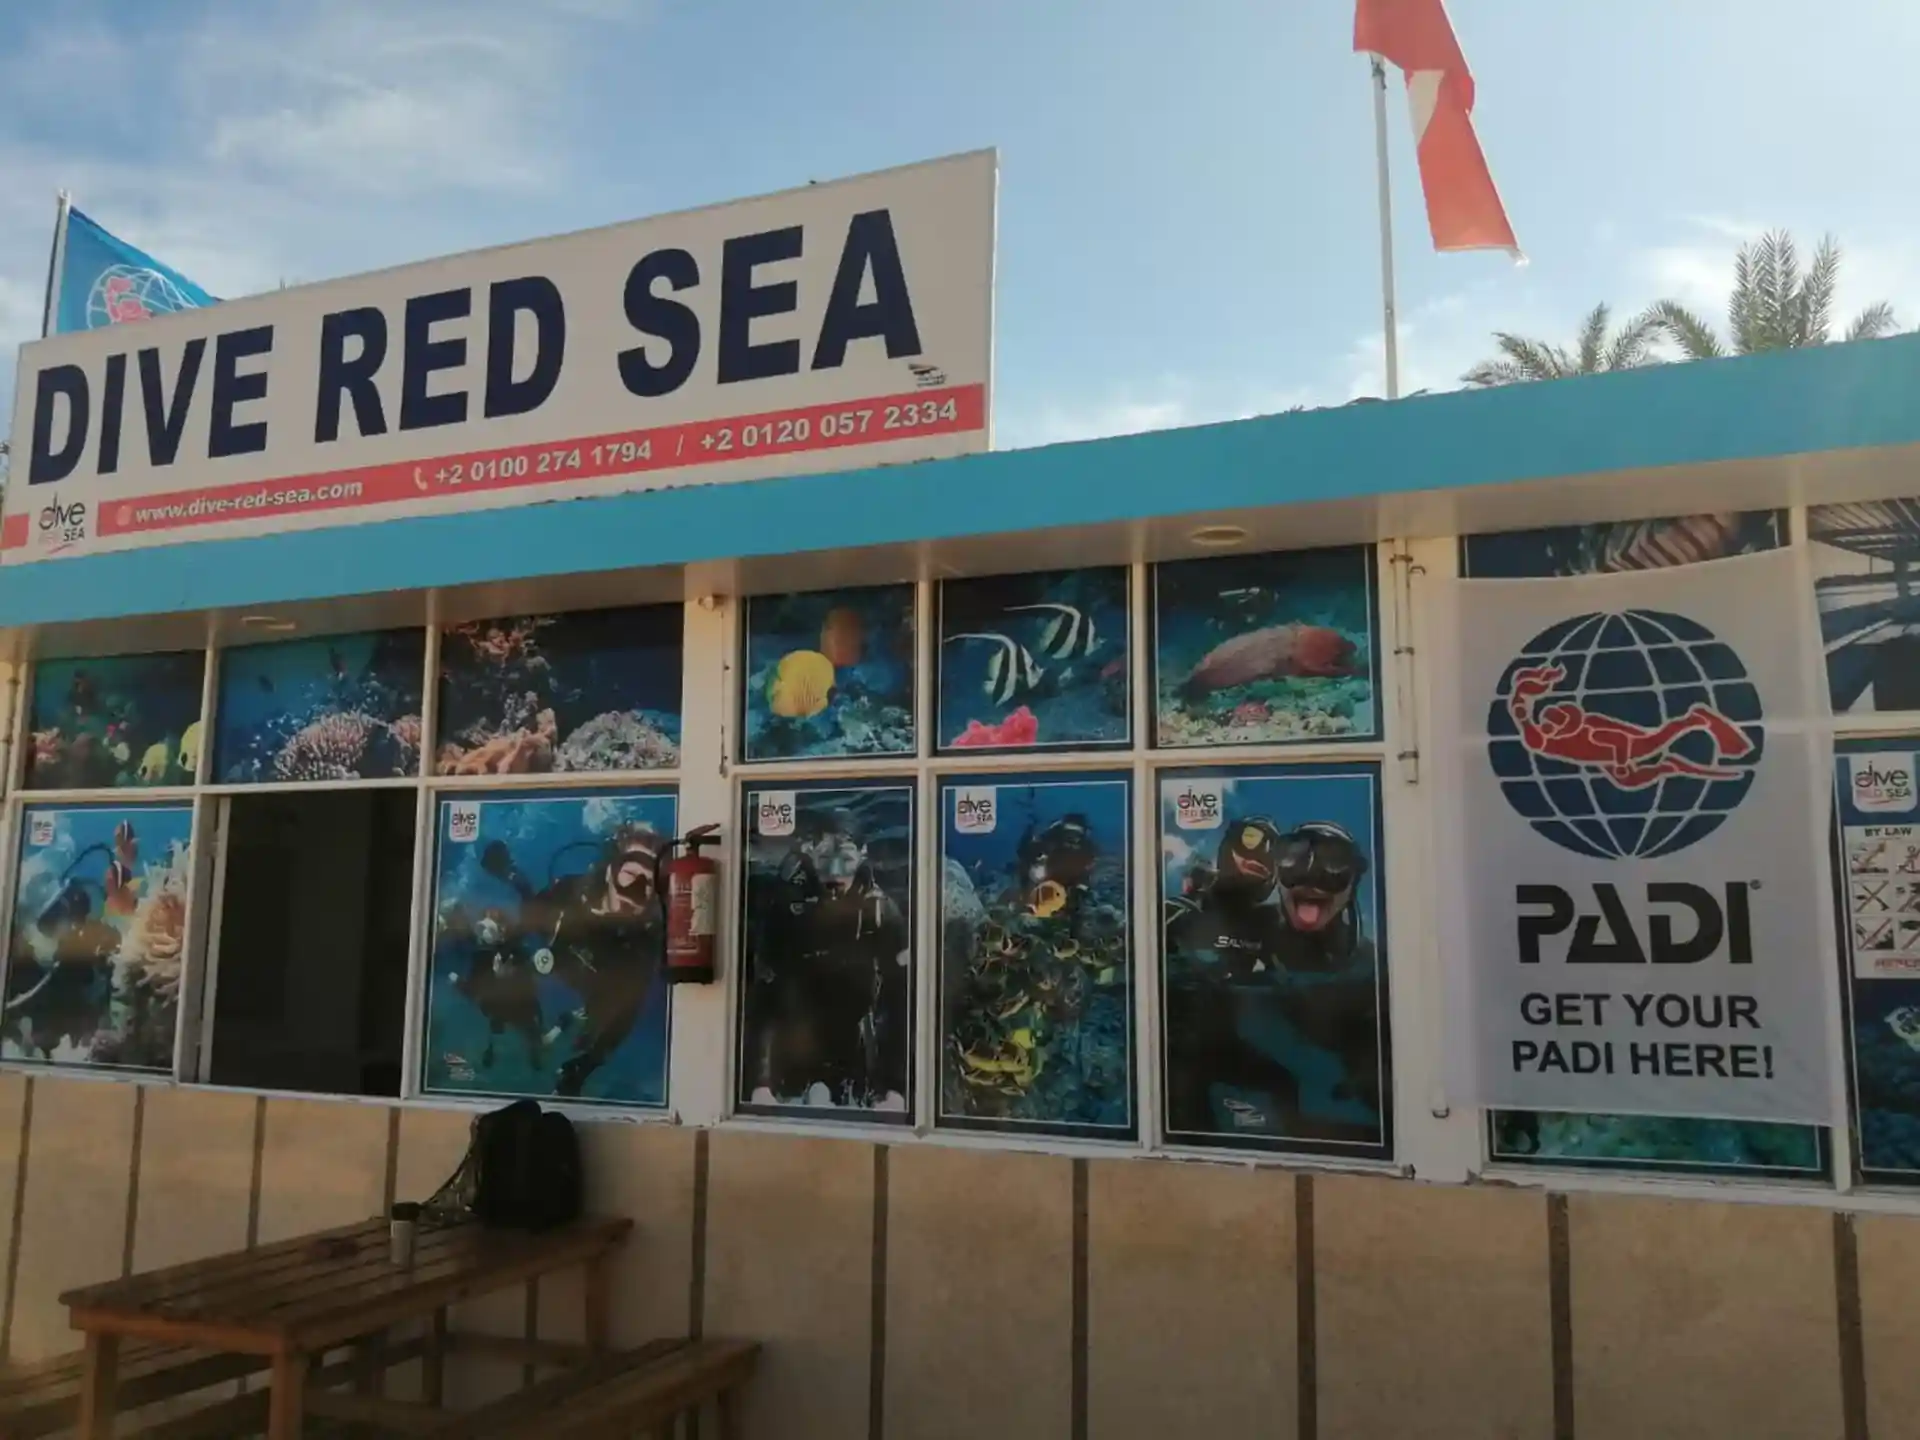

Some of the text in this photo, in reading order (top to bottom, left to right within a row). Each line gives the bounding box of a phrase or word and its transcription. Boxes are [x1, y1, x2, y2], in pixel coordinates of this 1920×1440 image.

[29, 209, 922, 485] DIVE RED SEA
[434, 463, 463, 485] +2
[470, 455, 528, 482] 0100
[536, 448, 581, 474] 274
[591, 439, 652, 467] 1794
[701, 428, 733, 451] +2
[742, 418, 810, 447] 0120
[820, 409, 874, 437] 057
[883, 397, 957, 430] 2334
[135, 481, 363, 524] www.dive-red-sea.com
[63, 527, 85, 542] SEA
[1885, 787, 1912, 797] SEA
[1885, 827, 1912, 837] LAW
[1516, 881, 1753, 964] PADI
[1520, 993, 1761, 1029] GET YOUR
[1512, 1040, 1774, 1079] PADI HERE!
